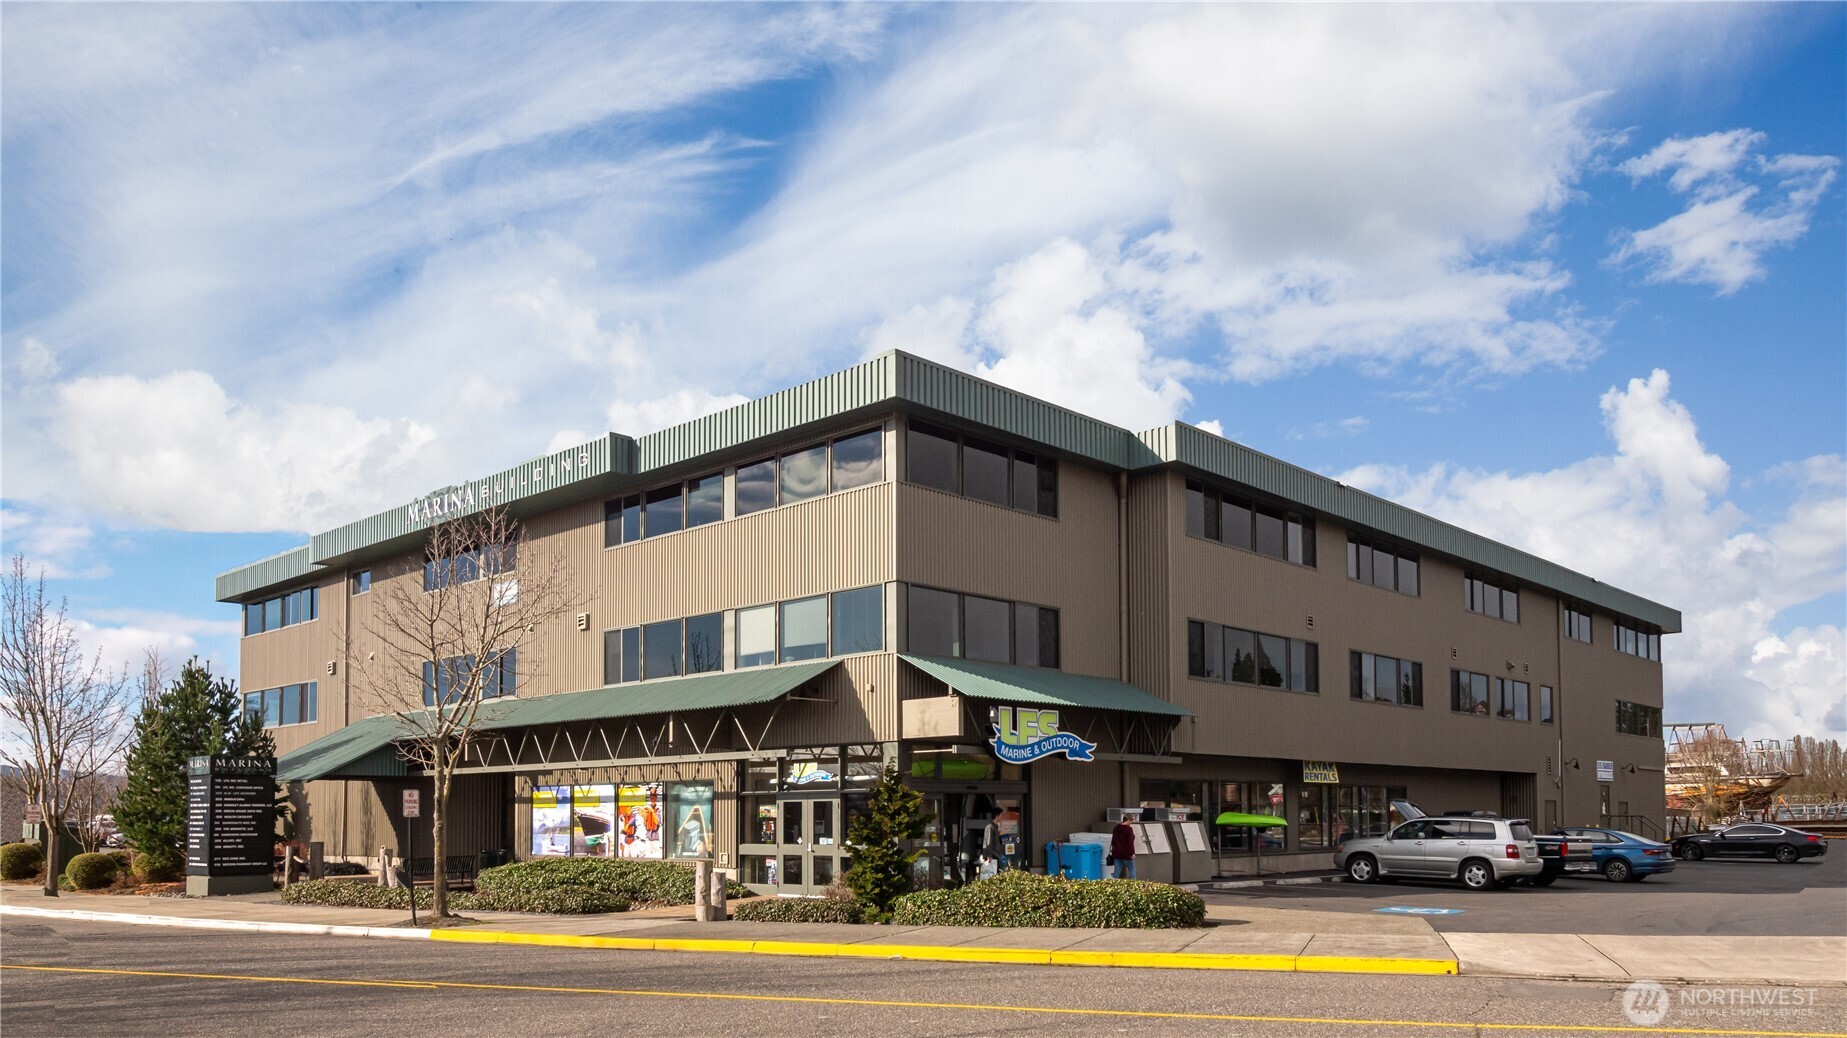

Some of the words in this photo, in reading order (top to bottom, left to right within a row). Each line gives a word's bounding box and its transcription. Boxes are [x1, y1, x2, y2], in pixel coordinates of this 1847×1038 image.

[406, 486, 475, 525] MARINA
[481, 453, 588, 498] BUILDING
[998, 706, 1059, 745] LFS
[1000, 744, 1033, 759] MARINE
[1033, 745, 1040, 754] &
[1041, 737, 1080, 752] OUTDOOR
[215, 759, 272, 768] MARINA
[1304, 760, 1336, 772] KAYAK
[1304, 772, 1338, 782] RENTALS
